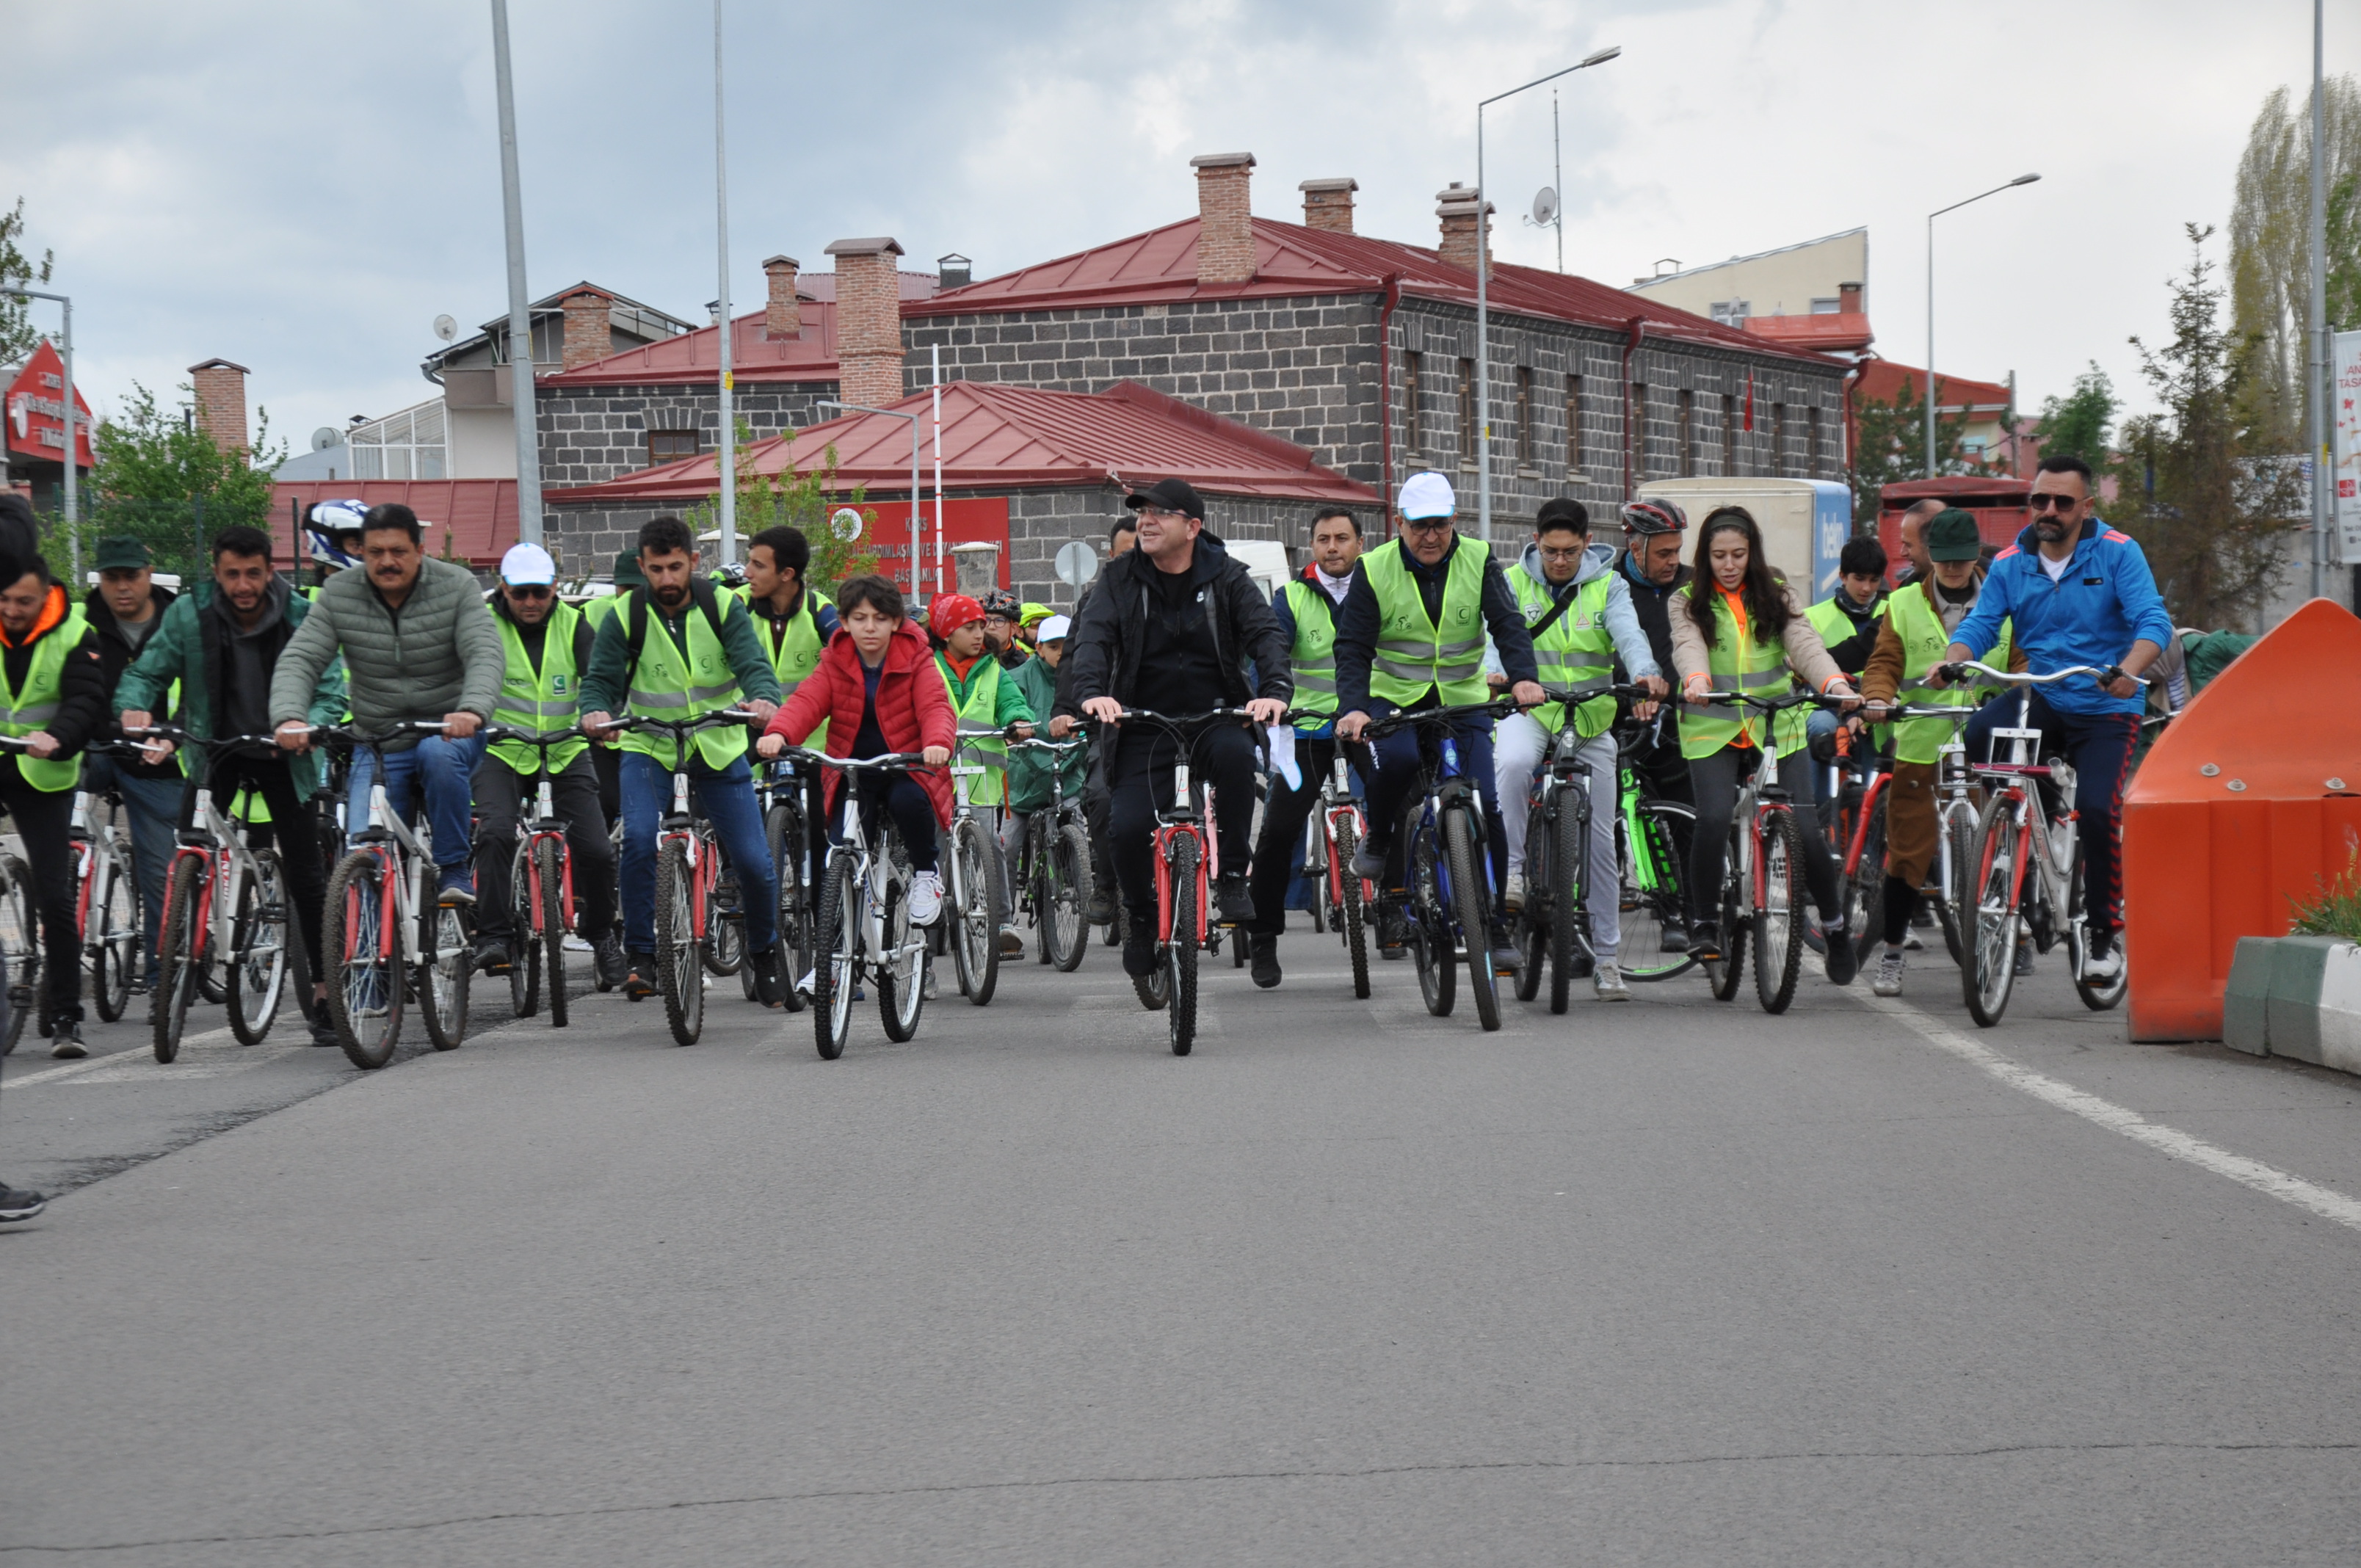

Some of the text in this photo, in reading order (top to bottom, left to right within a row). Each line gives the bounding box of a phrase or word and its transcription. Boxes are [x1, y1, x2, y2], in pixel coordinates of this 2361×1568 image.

[905, 518, 928, 531] KRS
[1823, 512, 1844, 559] beko
[863, 543, 915, 563] ARDIMLAŞM
[895, 567, 940, 587] BAŞANLI
